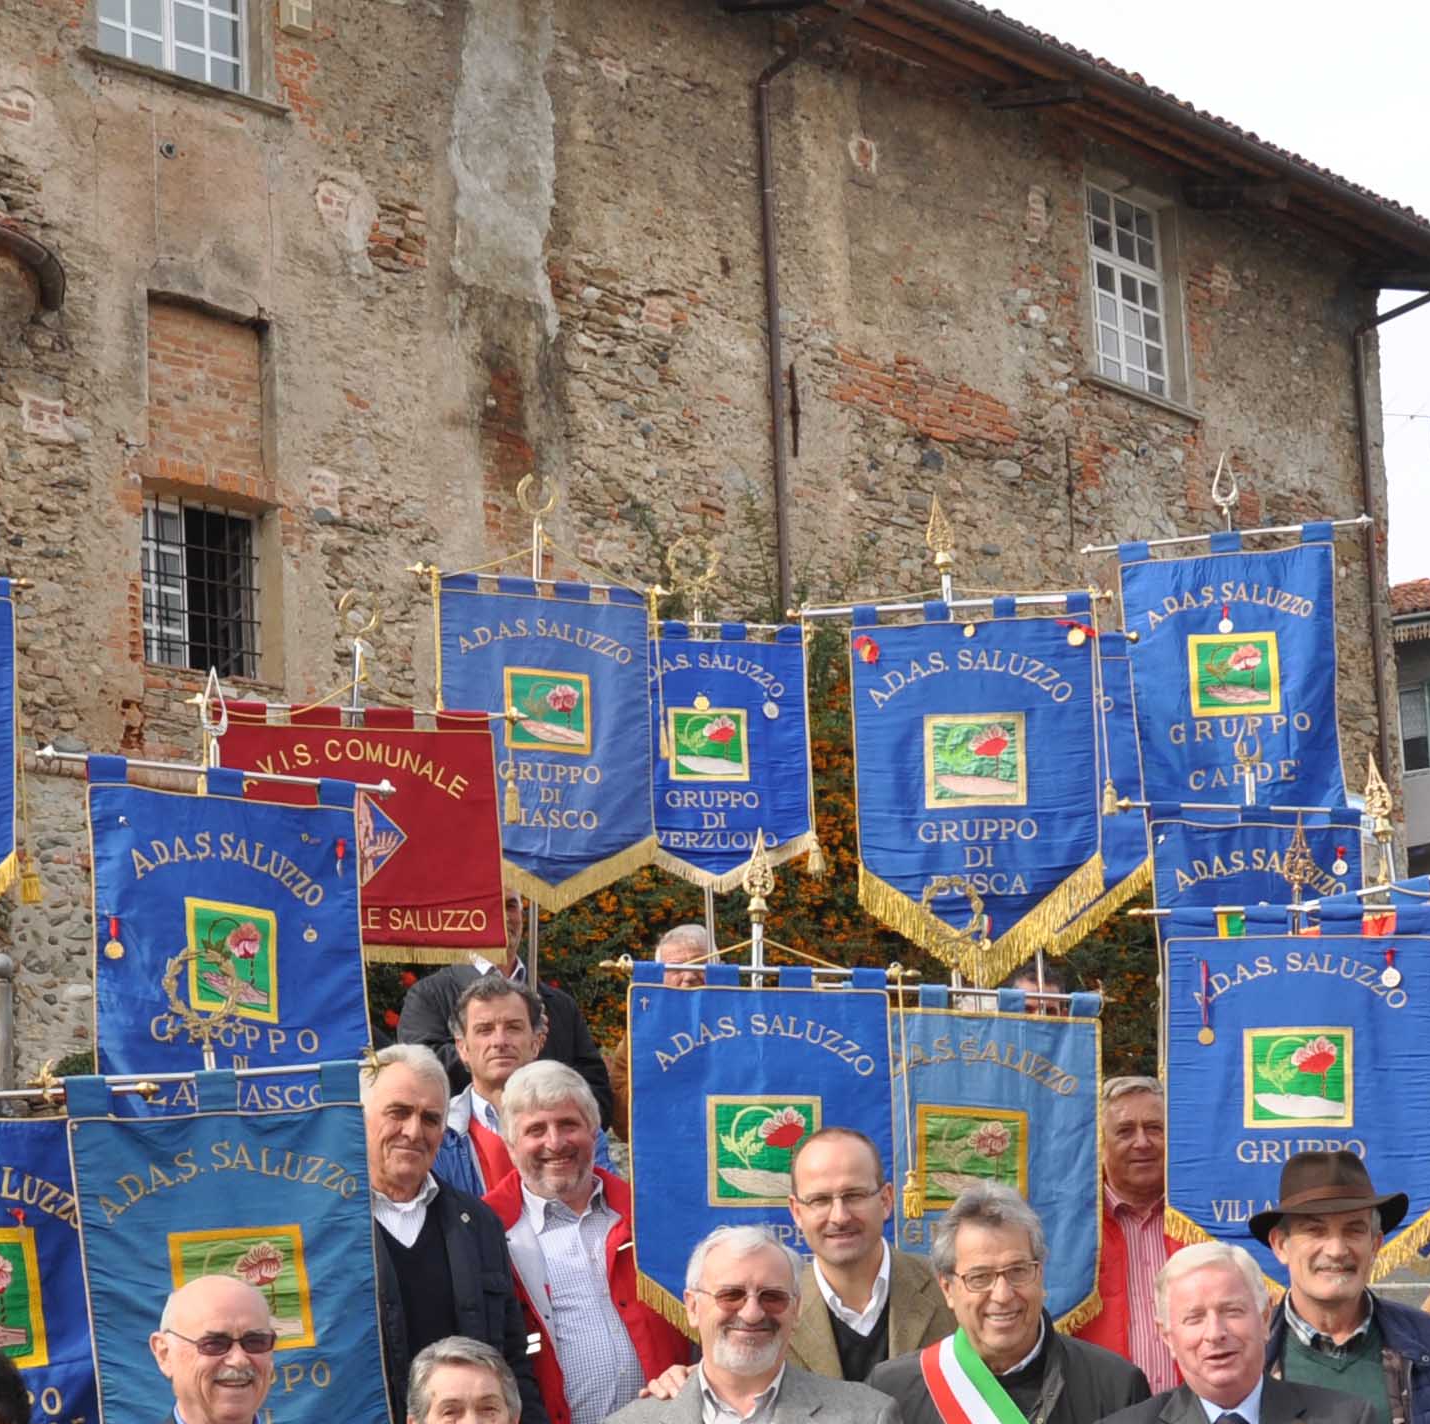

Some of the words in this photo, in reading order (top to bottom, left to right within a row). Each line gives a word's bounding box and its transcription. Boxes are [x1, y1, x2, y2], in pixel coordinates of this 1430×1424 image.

[1221, 580, 1314, 618] SALUZZO
[458, 618, 532, 655] A.D.A.S.
[536, 618, 632, 664] SALUZZO
[698, 653, 785, 699] SALUZZO
[868, 651, 950, 709] A.D.A.S.
[957, 649, 1073, 702] SALUZZO
[1169, 711, 1312, 745] GRUPPO
[324, 739, 469, 799] COMUNALE
[498, 760, 602, 785] GRUPPO
[539, 787, 563, 804] DI
[665, 790, 760, 809] GRUPPO
[503, 807, 599, 830] IASCO
[701, 812, 727, 829] DI
[917, 817, 1039, 843] GRUPPO
[131, 831, 216, 880] A.D.A.S.
[219, 832, 323, 906] SALUZZO
[963, 845, 995, 868] DI
[1174, 848, 1250, 893] A.D.A.S.
[1251, 848, 1347, 897] SAZZO
[388, 907, 487, 932] SALUZZO
[1286, 952, 1408, 1009] SALUZZO
[654, 1015, 742, 1072] A.D.A.S.
[750, 1013, 876, 1077] SALUZZO
[98, 1149, 207, 1225] A.D.A.S.
[211, 1141, 359, 1199] SALUZZO
